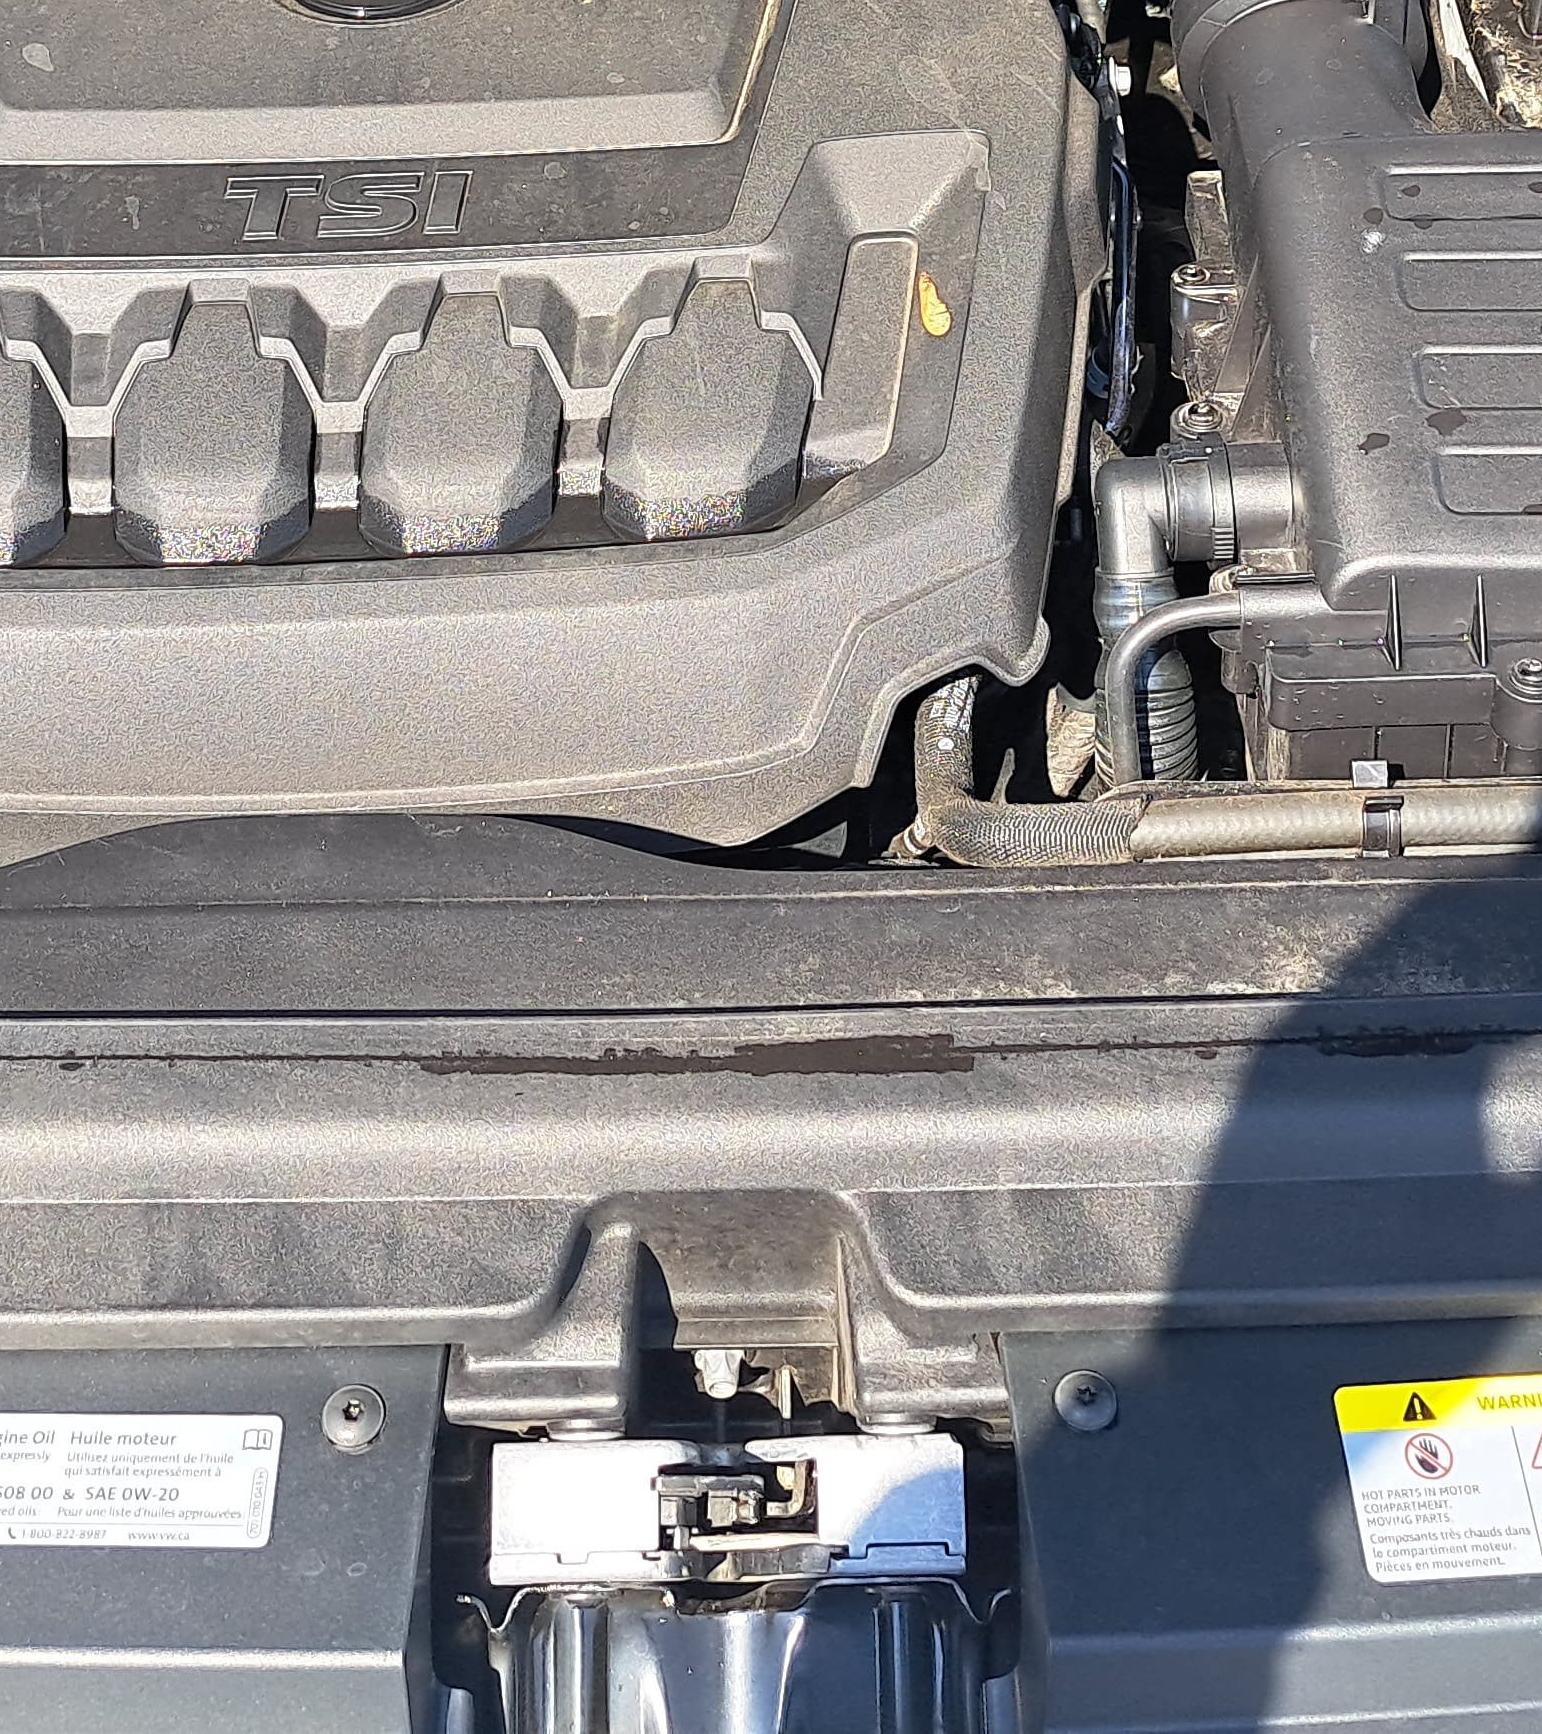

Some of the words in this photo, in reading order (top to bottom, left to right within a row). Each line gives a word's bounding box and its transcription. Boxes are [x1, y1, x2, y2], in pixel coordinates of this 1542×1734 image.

[225, 170, 473, 241] TSI
[33, 1430, 56, 1444] Oil
[71, 1431, 112, 1446] Huile
[117, 1433, 177, 1446] moteur
[1, 1451, 51, 1462] expressly
[67, 1453, 108, 1462] Utilisez
[111, 1453, 180, 1465] uniquement
[184, 1453, 198, 1463] de
[64, 1467, 83, 1478] qui
[85, 1467, 129, 1476] satisfait
[132, 1468, 211, 1478] expressément
[31, 1486, 53, 1499] 00
[62, 1488, 75, 1499] &
[85, 1487, 116, 1500] SAE
[122, 1487, 180, 1501] 0W-20
[1361, 1490, 1383, 1500] HOT
[1388, 1488, 1422, 1499] PARTS
[1425, 1487, 1436, 1496] IN
[1439, 1485, 1480, 1496] MOTOR
[58, 1507, 83, 1516] Pour
[85, 1508, 106, 1517] une
[109, 1507, 132, 1517] liste
[134, 1507, 175, 1518] d'huiles
[1367, 1516, 1412, 1527] MOVING
[1370, 1532, 1438, 1545] Composants
[1441, 1528, 1461, 1539] très
[1464, 1527, 1502, 1538] chauds
[1505, 1526, 1531, 1536] dans
[1387, 1543, 1467, 1557] compartiment
[1471, 1541, 1516, 1552] moteur.
[1376, 1561, 1411, 1573] Pièces
[1416, 1560, 1429, 1570] en
[1433, 1557, 1505, 1568] mouvement.
